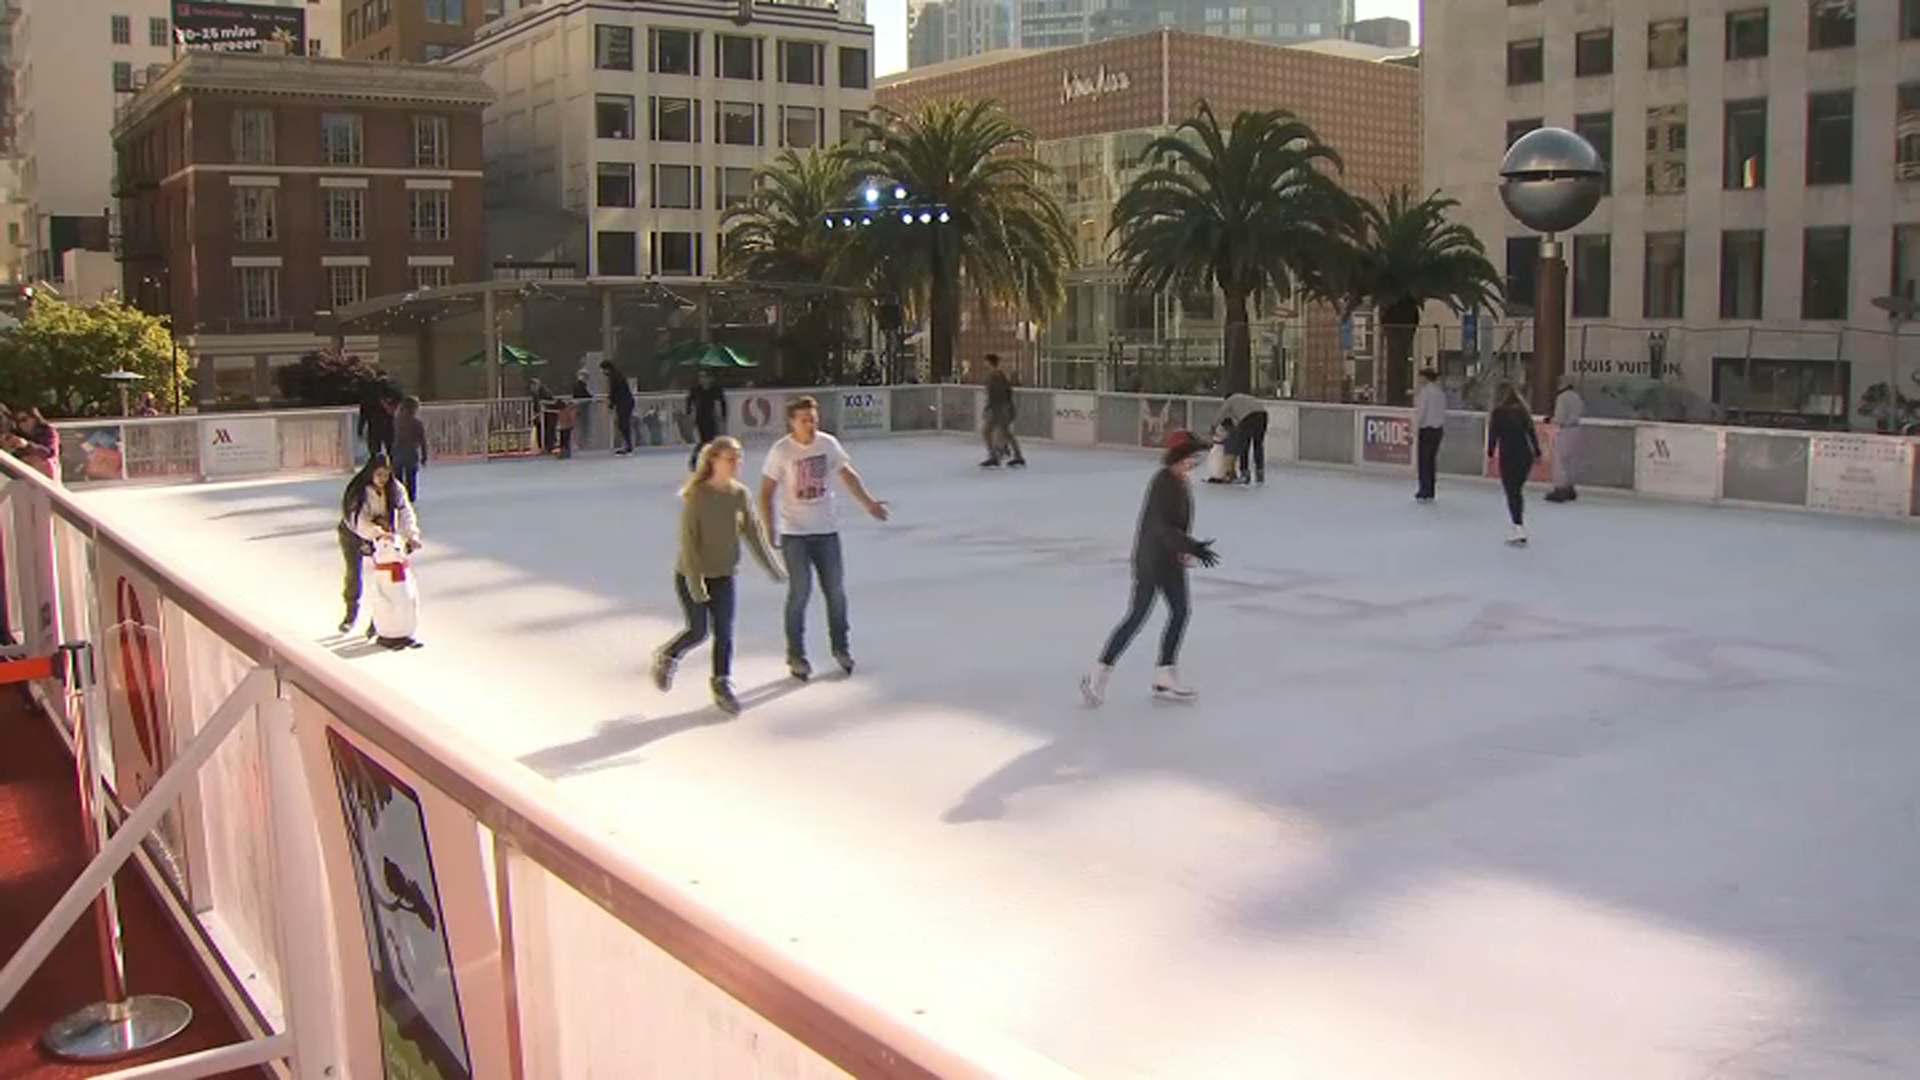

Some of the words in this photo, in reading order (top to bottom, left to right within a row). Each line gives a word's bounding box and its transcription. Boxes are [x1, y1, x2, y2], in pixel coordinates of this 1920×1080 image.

[176, 27, 219, 41] 0-15
[221, 24, 256, 39] mins
[1572, 360, 1611, 373] LOUIS
[1615, 361, 1682, 375] VUITN
[1367, 420, 1410, 445] PRIDE
